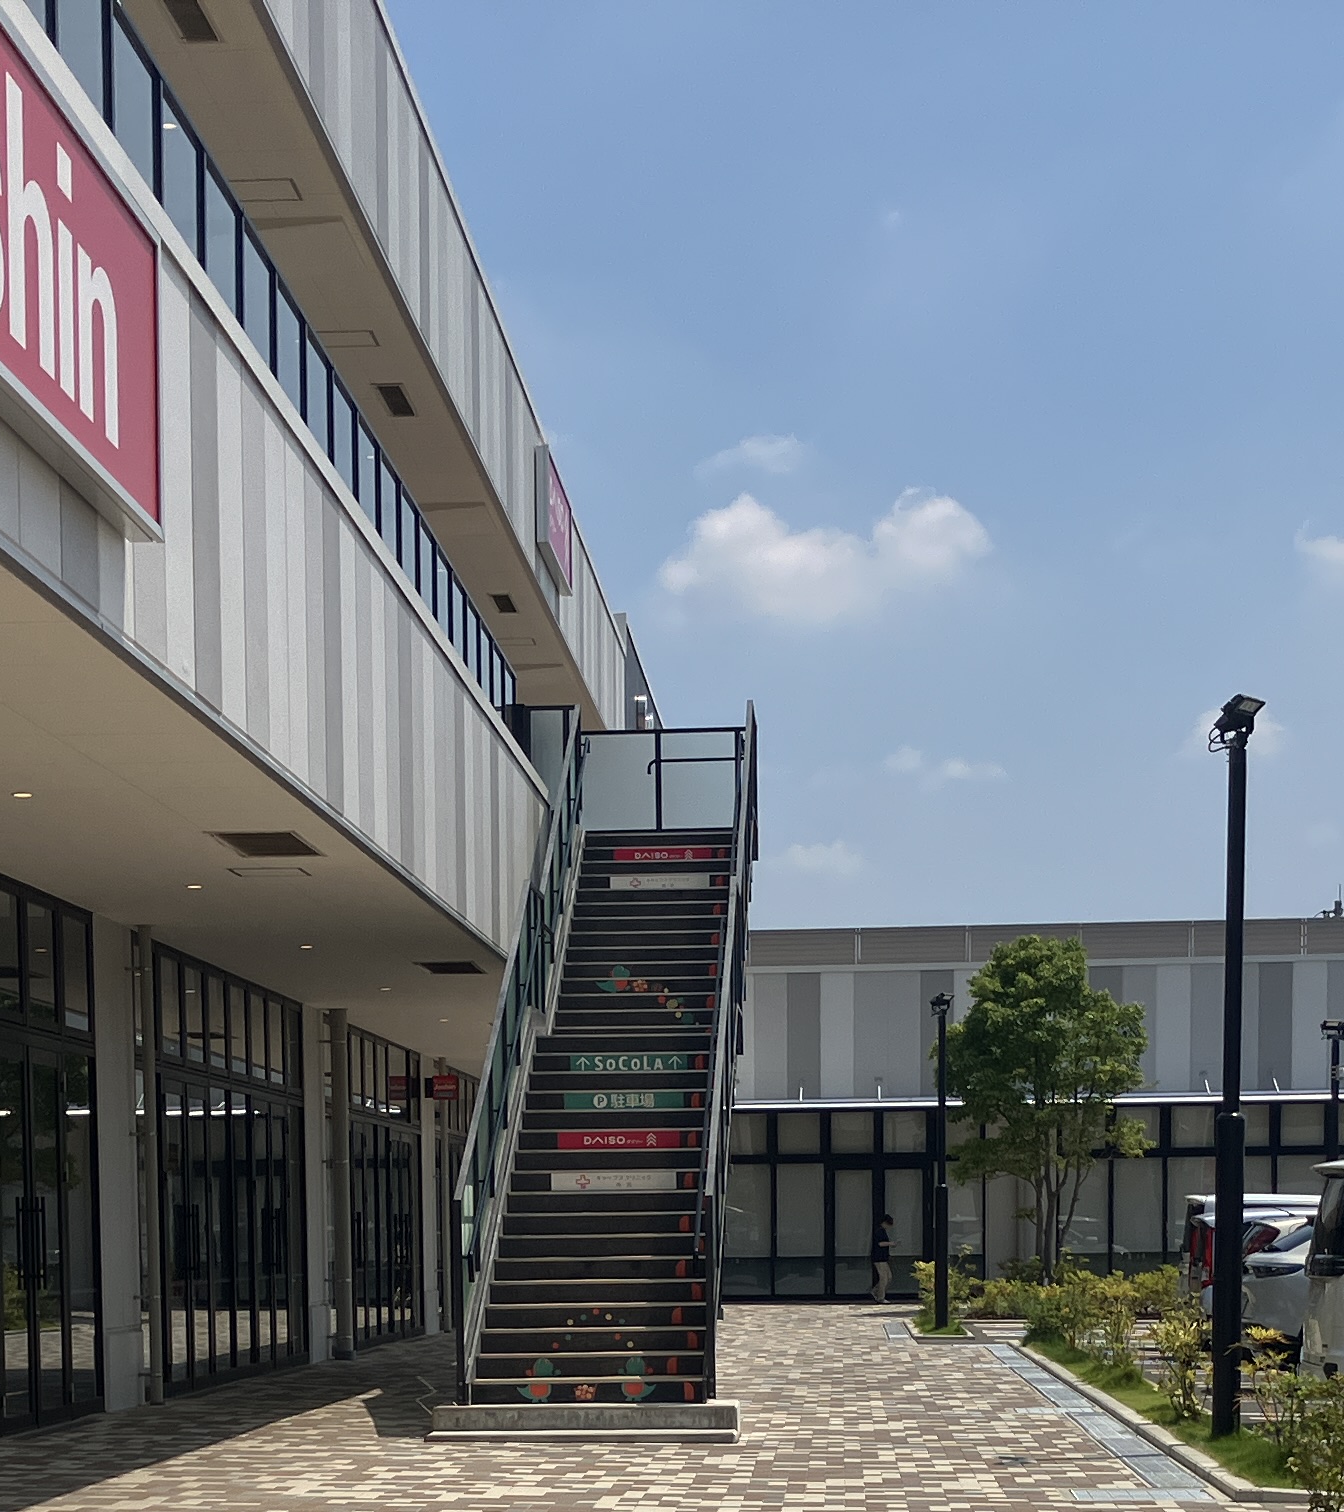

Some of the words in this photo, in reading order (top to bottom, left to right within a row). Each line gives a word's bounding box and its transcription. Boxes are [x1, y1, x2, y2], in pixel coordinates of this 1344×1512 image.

[594, 1056, 664, 1071] SoCoLa
[610, 1093, 655, 1108] 駐車場
[583, 1136, 626, 1145] DAISO
